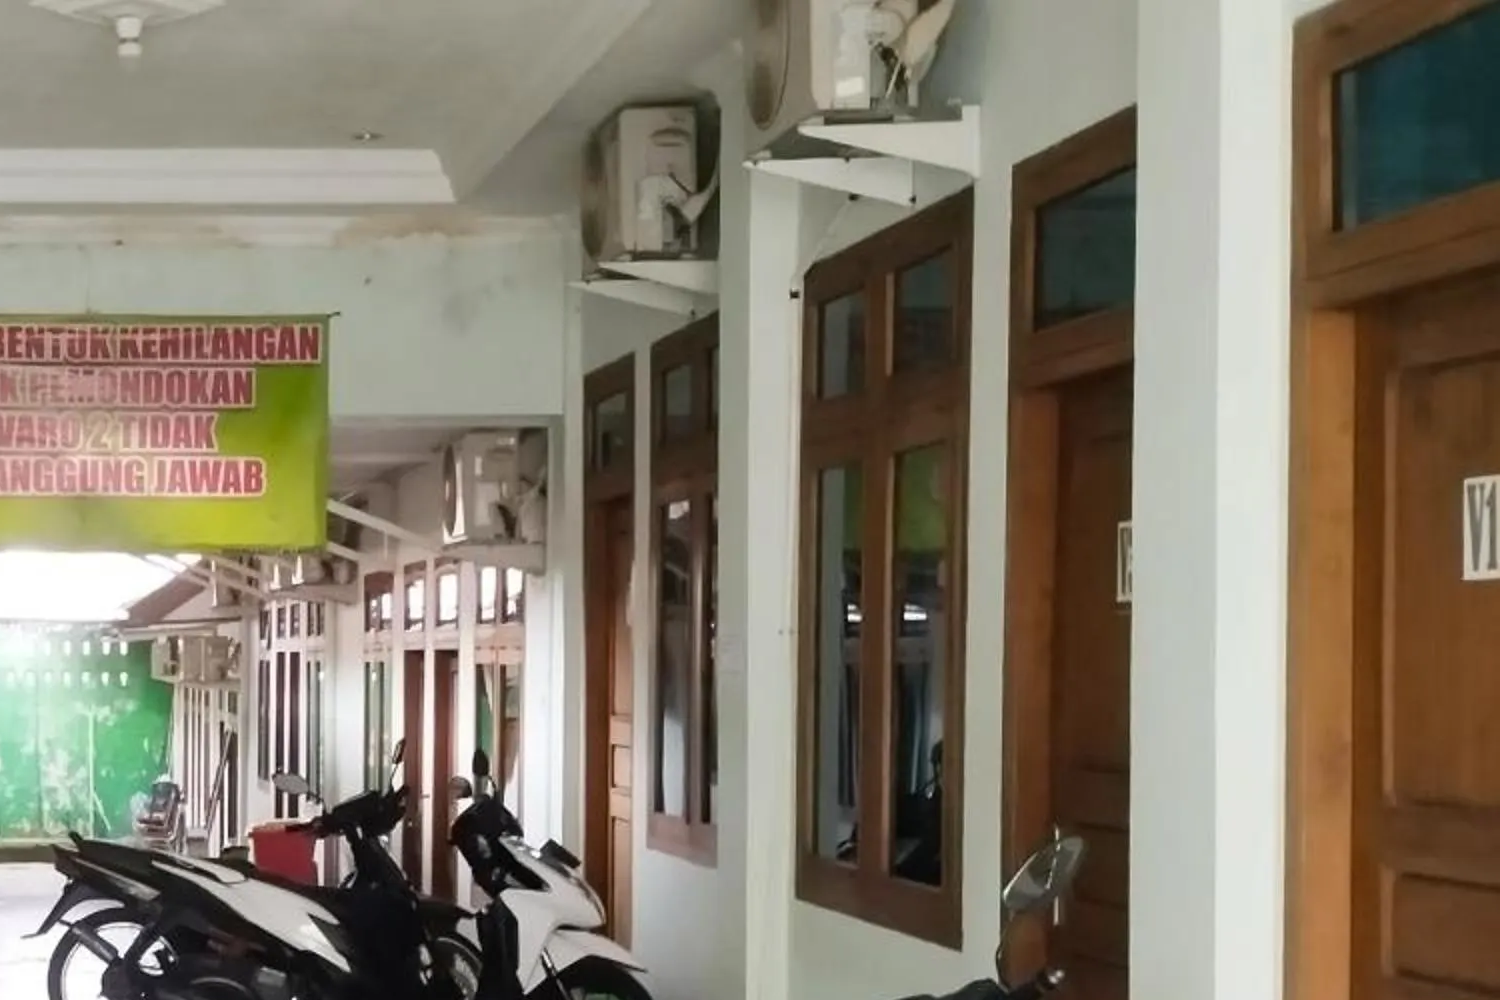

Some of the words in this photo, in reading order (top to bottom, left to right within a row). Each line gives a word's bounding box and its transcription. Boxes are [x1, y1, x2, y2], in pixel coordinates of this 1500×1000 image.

[118, 325, 321, 362] KEHILANGAN
[87, 412, 112, 450] 2
[116, 413, 216, 450] TIDAK
[154, 458, 265, 495] JAWAB
